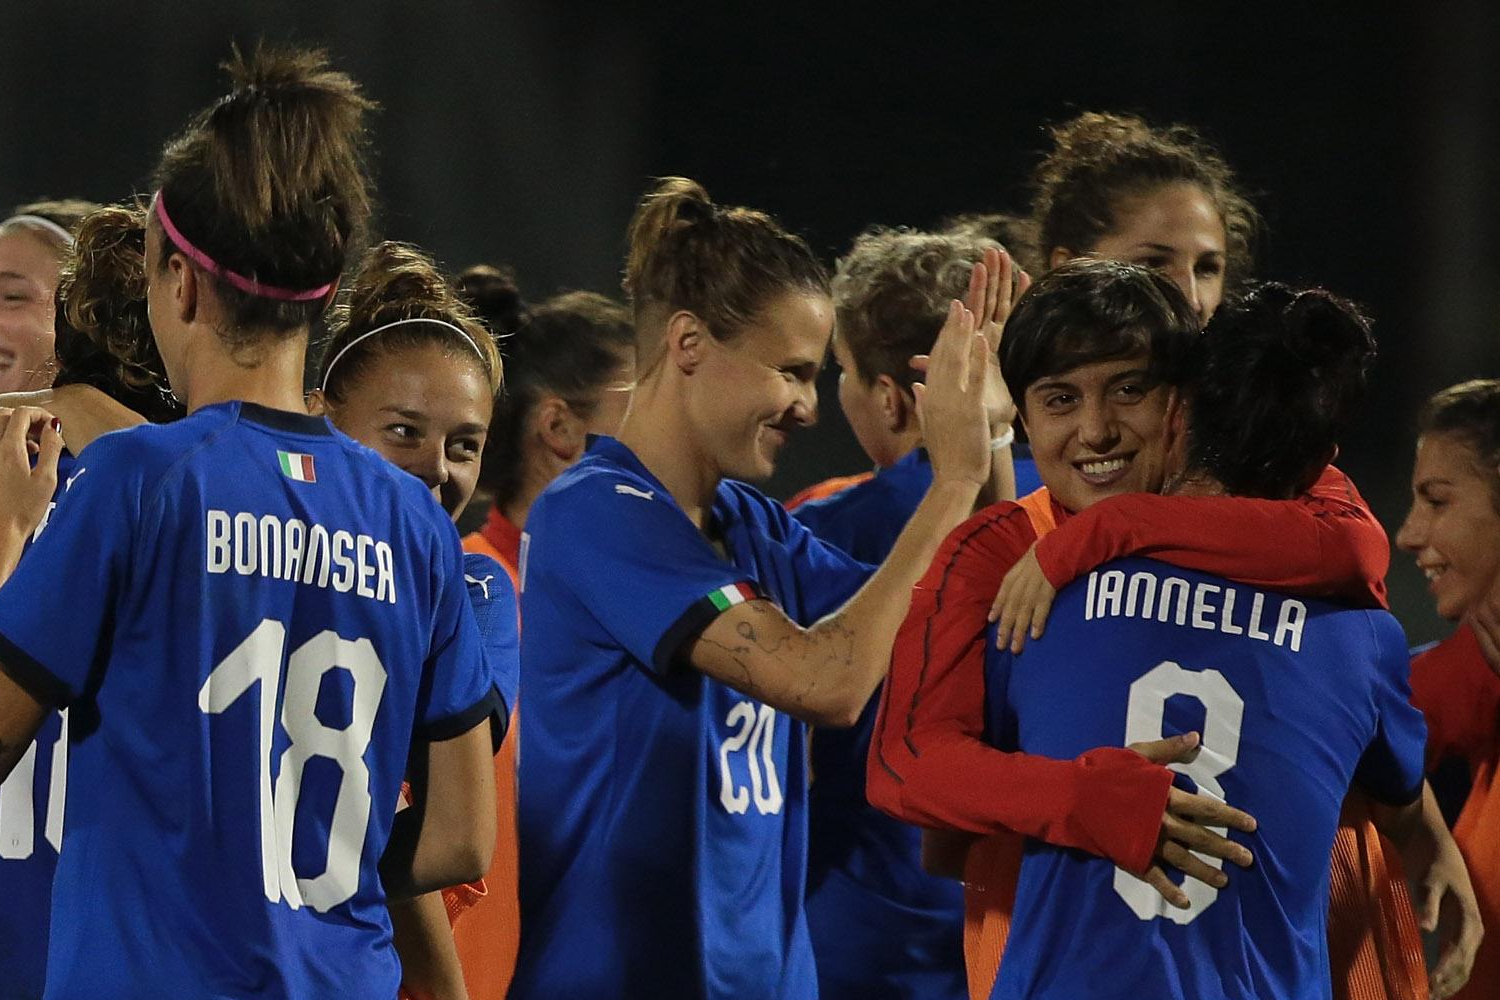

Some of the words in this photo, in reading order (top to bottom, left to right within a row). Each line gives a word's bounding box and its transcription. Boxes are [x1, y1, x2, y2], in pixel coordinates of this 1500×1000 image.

[206, 509, 396, 605] BONANSEA
[1085, 570, 1308, 653] IANNELLA
[199, 618, 387, 913] 18
[720, 701, 784, 815] 20
[1113, 660, 1244, 925] 8
